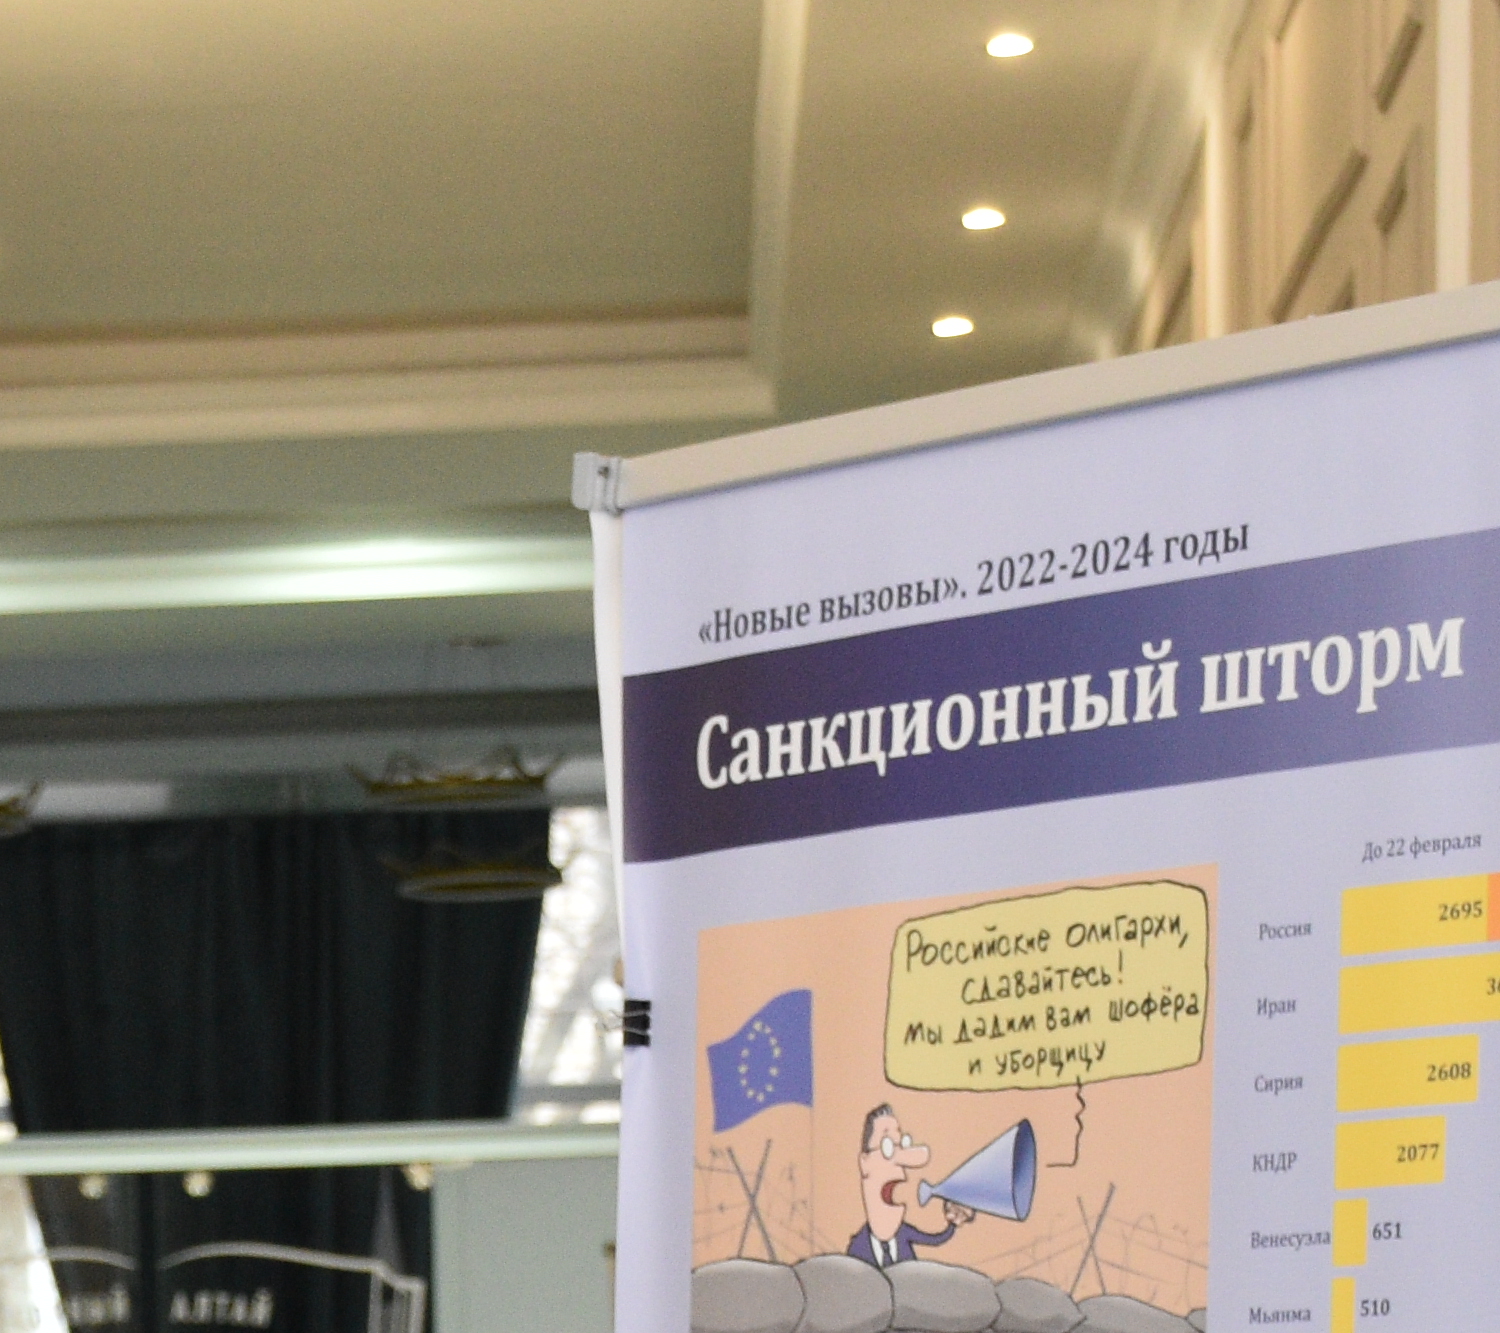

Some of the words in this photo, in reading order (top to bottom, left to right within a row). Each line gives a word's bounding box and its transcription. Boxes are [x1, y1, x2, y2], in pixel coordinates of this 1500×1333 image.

[699, 600, 810, 646] «Новые
[818, 570, 966, 625] вызовы».
[976, 531, 1152, 598] 2022-2024
[1163, 523, 1249, 574] годы
[696, 640, 1180, 792] Санкционный
[1199, 616, 1465, 715] шторм
[1360, 840, 1384, 865] До
[1386, 836, 1406, 859] 22
[1408, 832, 1483, 861] февраля
[1438, 899, 1484, 923] 2695
[1259, 919, 1312, 942] Россия
[906, 924, 1051, 973] Российские
[1256, 995, 1297, 1018] Иран
[968, 1057, 983, 1077] и
[995, 1040, 1107, 1077] уборщицу
[1426, 1061, 1472, 1084] 2608
[1254, 1073, 1304, 1097] Сирия
[1252, 1151, 1298, 1174] КНДР
[1396, 1143, 1440, 1163] 2077
[1250, 1228, 1331, 1252] Венесуэла
[1372, 1222, 1403, 1240] 651
[1249, 1306, 1312, 1325] Мьянма
[1359, 1299, 1391, 1317] 510
